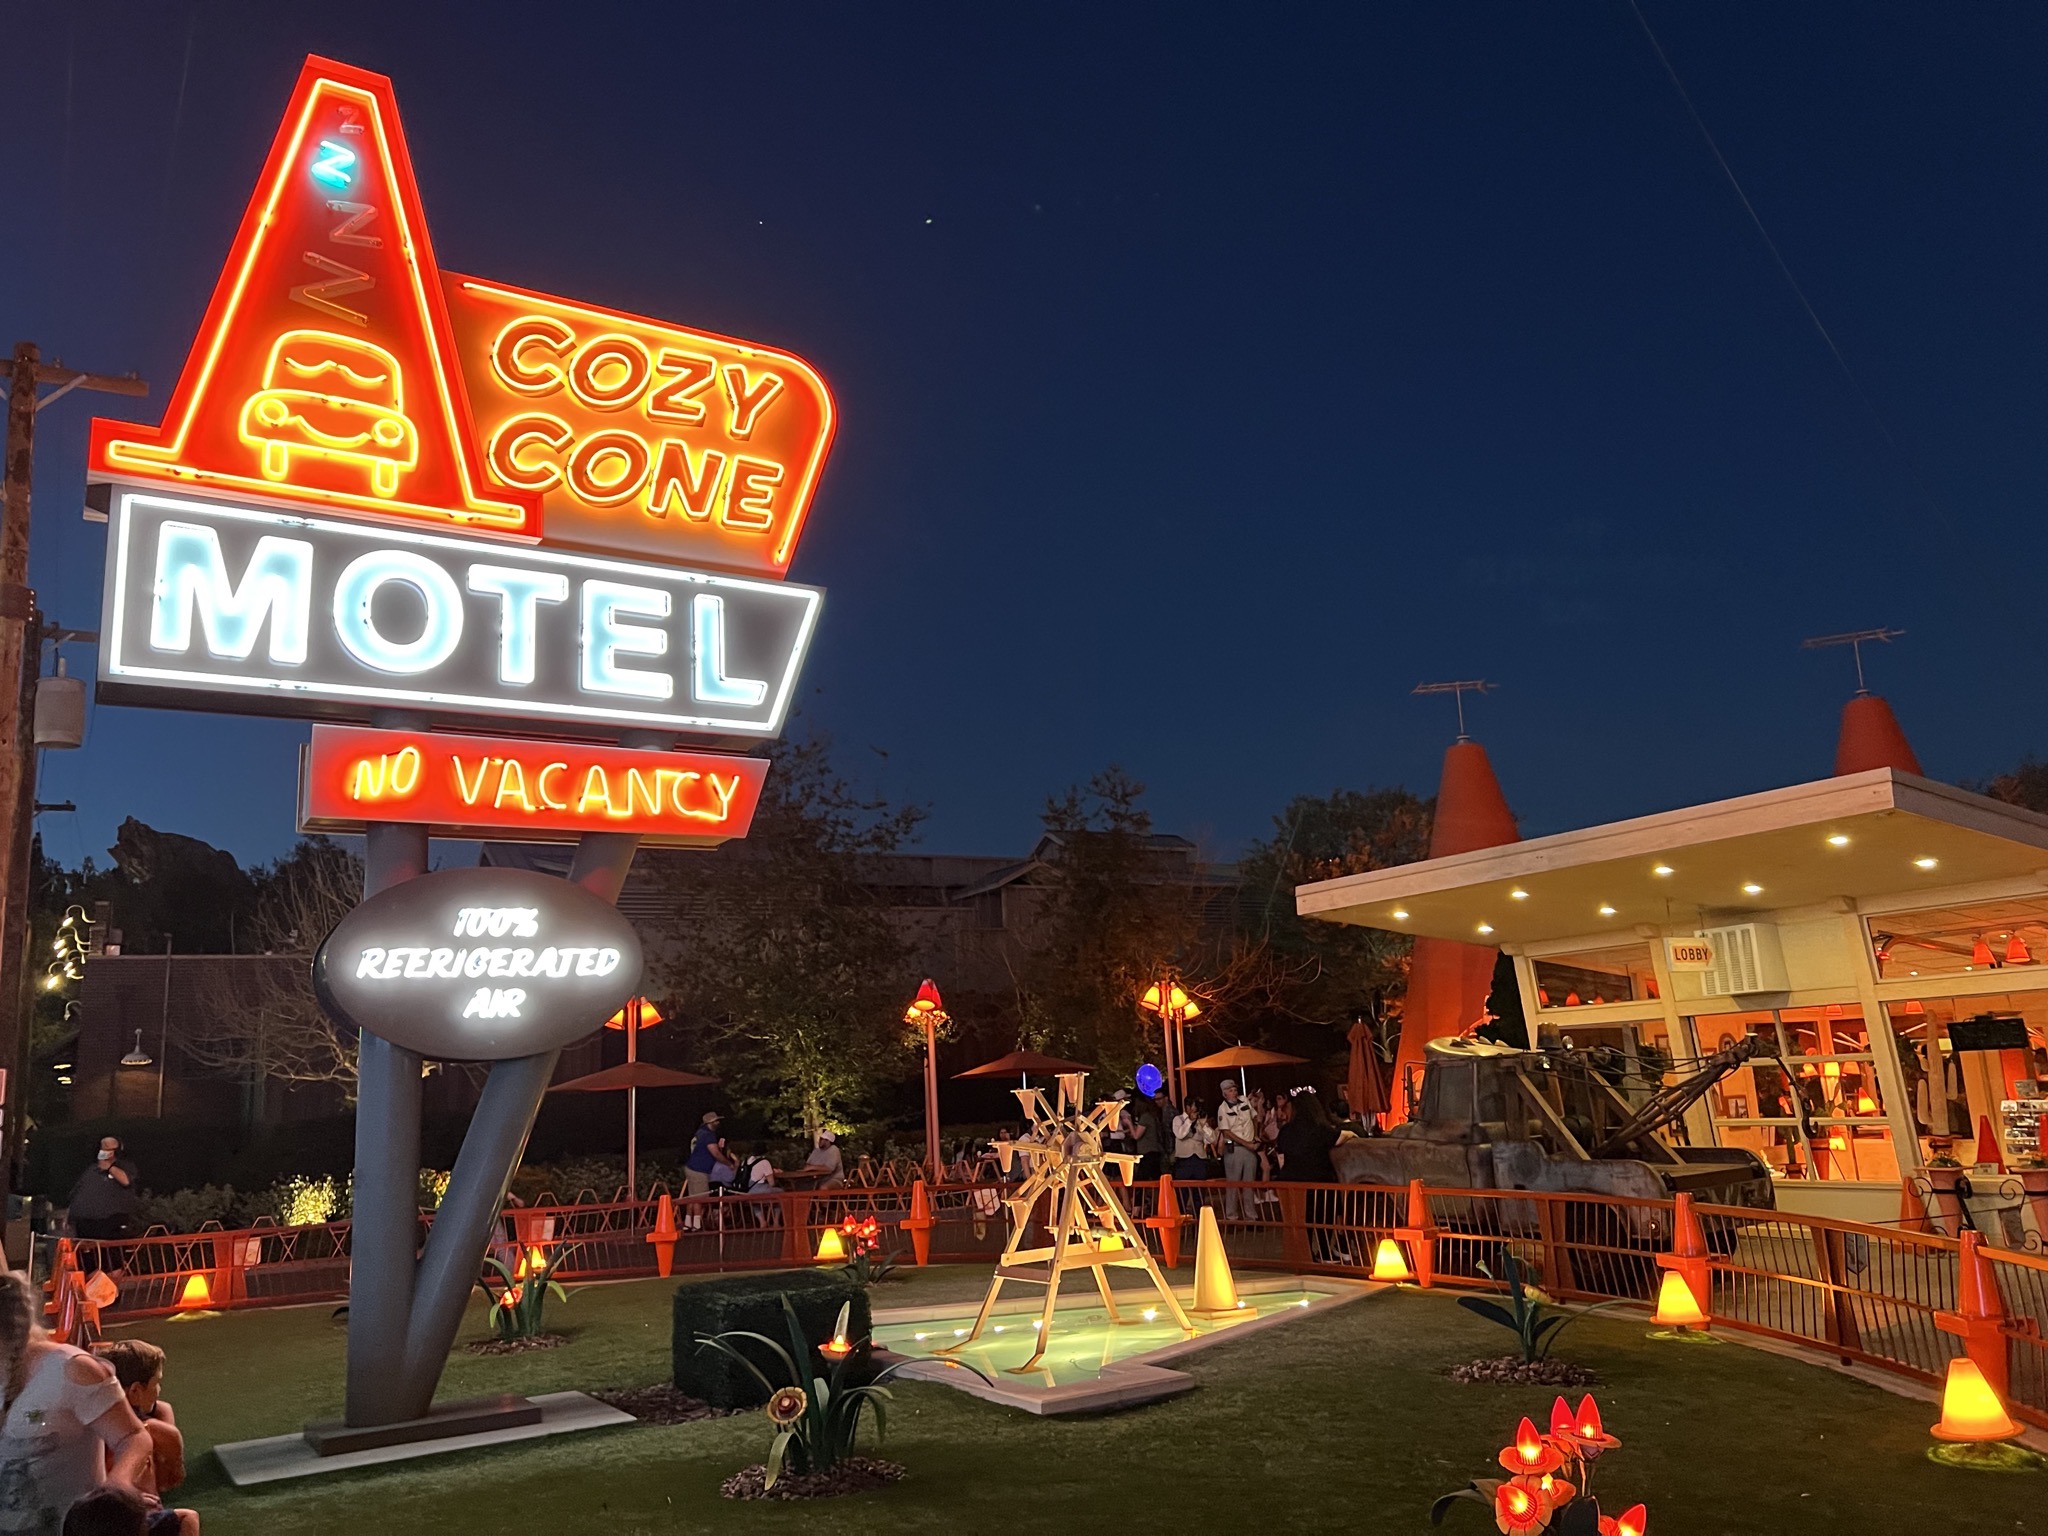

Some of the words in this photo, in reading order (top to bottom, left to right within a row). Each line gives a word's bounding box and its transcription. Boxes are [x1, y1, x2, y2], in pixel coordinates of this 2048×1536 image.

[492, 315, 783, 440] COZY
[489, 412, 784, 533] CONE
[149, 520, 769, 706] MOTEL
[353, 746, 420, 801] NO
[453, 755, 740, 821] VACANCY
[453, 907, 539, 938] 100%
[1674, 947, 1708, 961] LOBBY
[462, 987, 527, 1019] AIR
